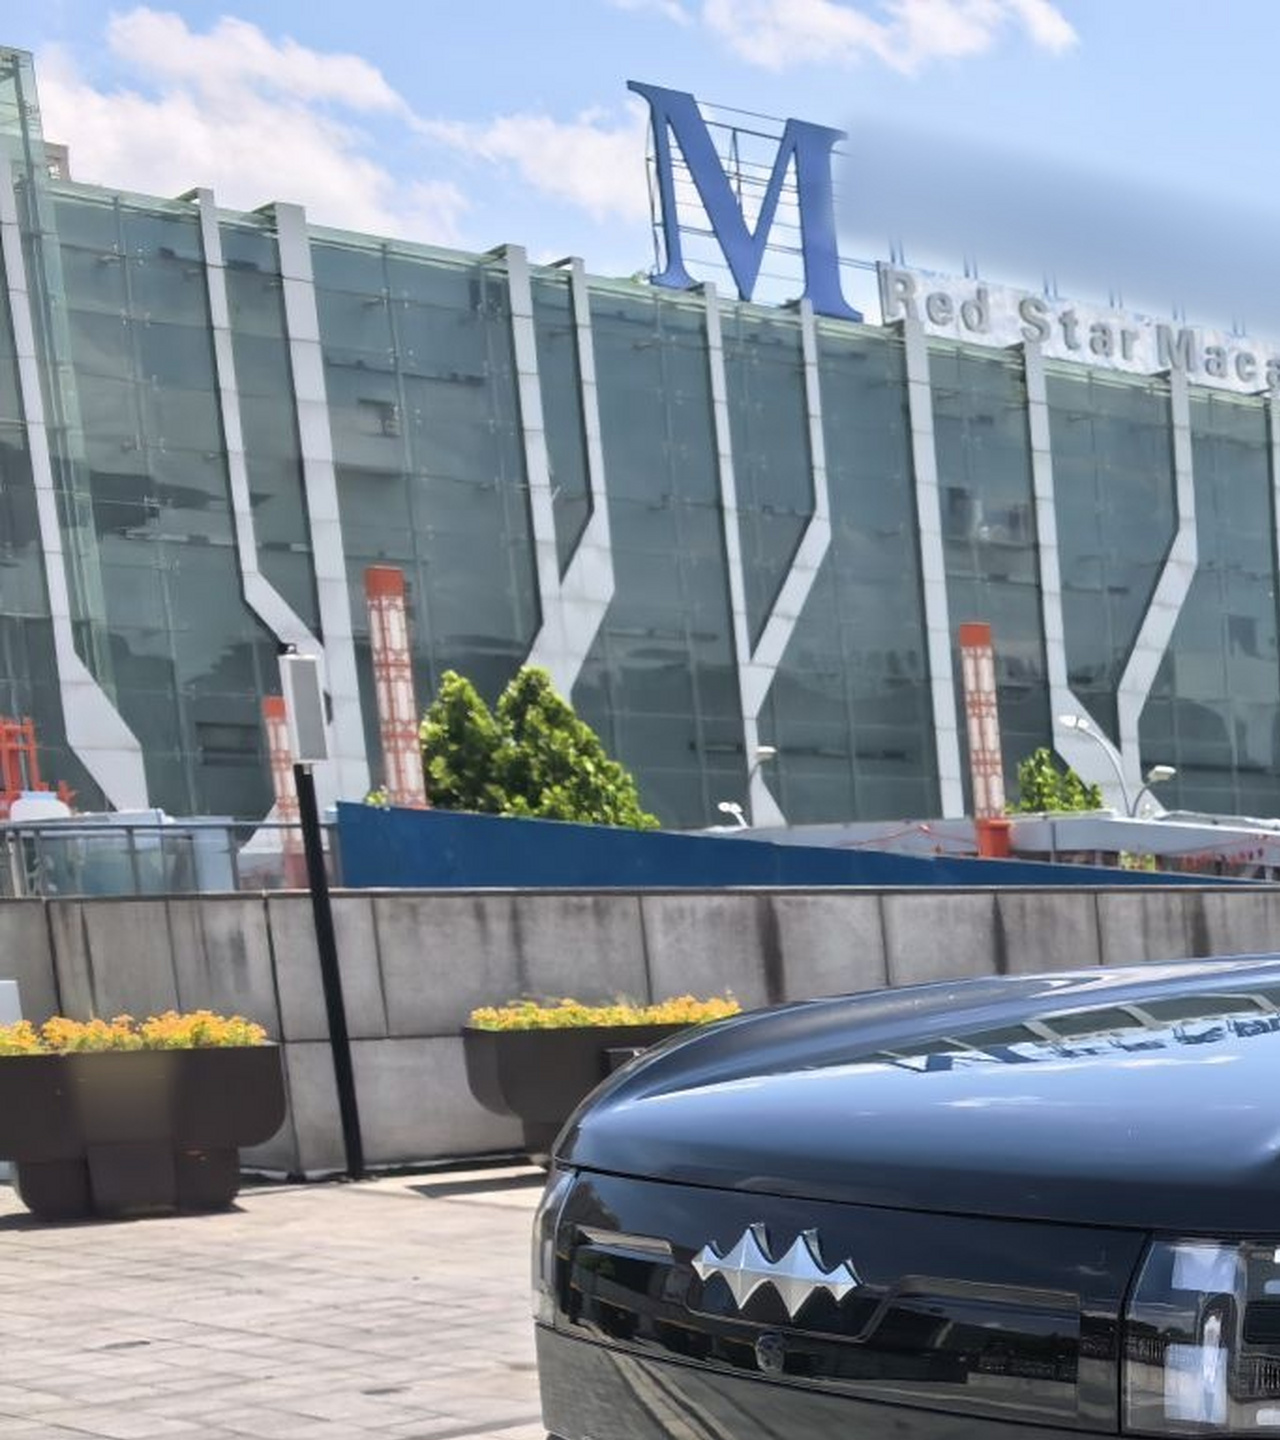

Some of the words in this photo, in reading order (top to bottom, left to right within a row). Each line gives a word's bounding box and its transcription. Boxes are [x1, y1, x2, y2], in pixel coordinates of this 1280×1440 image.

[627, 79, 863, 322] M
[884, 268, 989, 335] Red
[1019, 297, 1139, 361] Star
